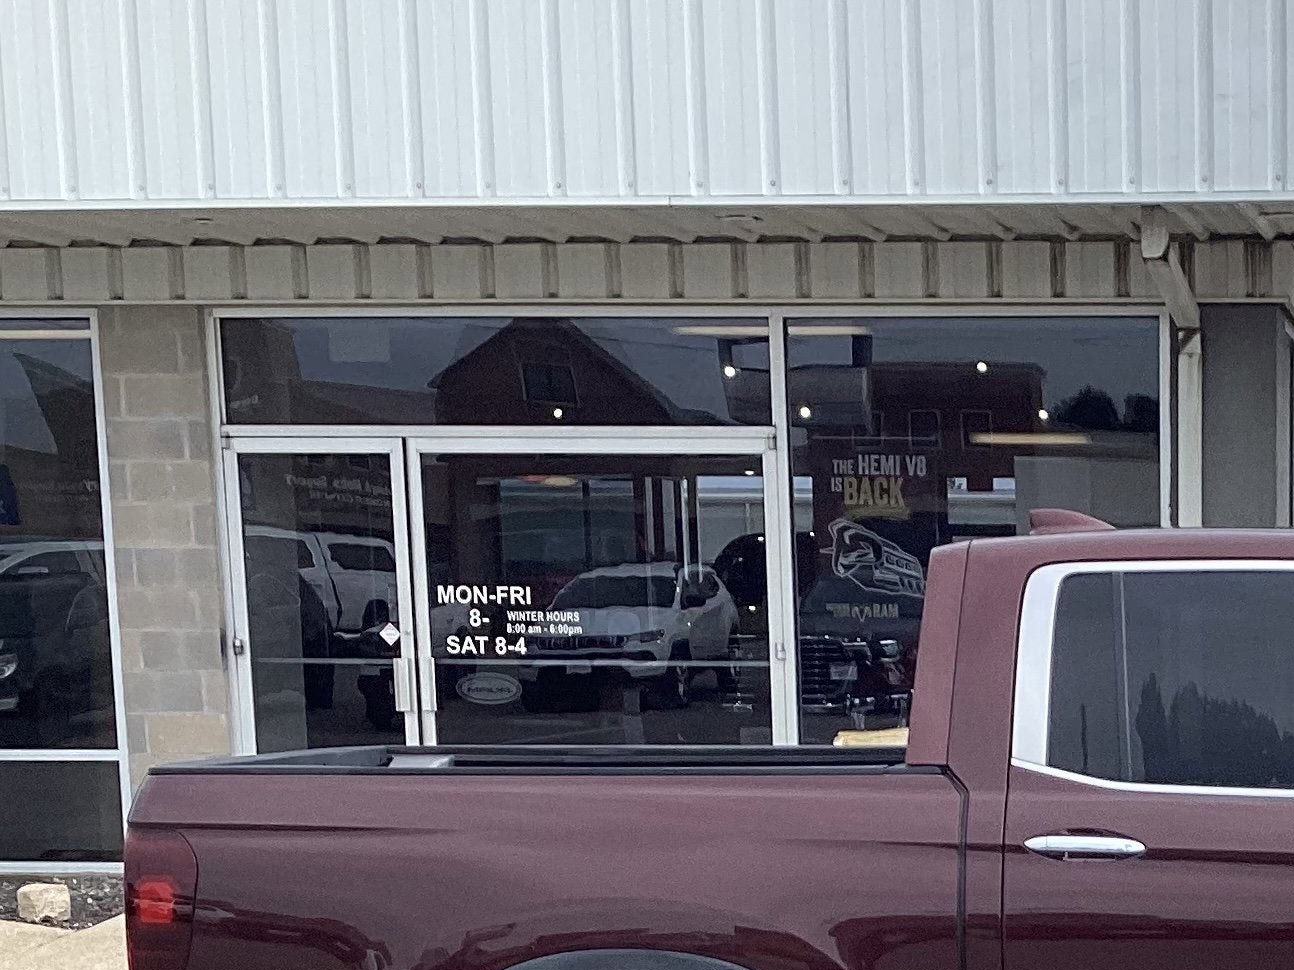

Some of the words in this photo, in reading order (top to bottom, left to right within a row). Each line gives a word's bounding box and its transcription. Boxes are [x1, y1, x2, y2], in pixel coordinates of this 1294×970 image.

[832, 459, 855, 474] THE
[858, 454, 900, 475] HEMI
[905, 455, 927, 476] V8
[831, 477, 842, 491] IS
[843, 476, 905, 507] BACK
[437, 585, 532, 605] MON-FRI
[469, 609, 490, 627] 8-
[507, 611, 544, 622] WINTER
[546, 611, 580, 622] HOURS
[446, 635, 489, 654] SAT
[495, 637, 527, 655] 8-4
